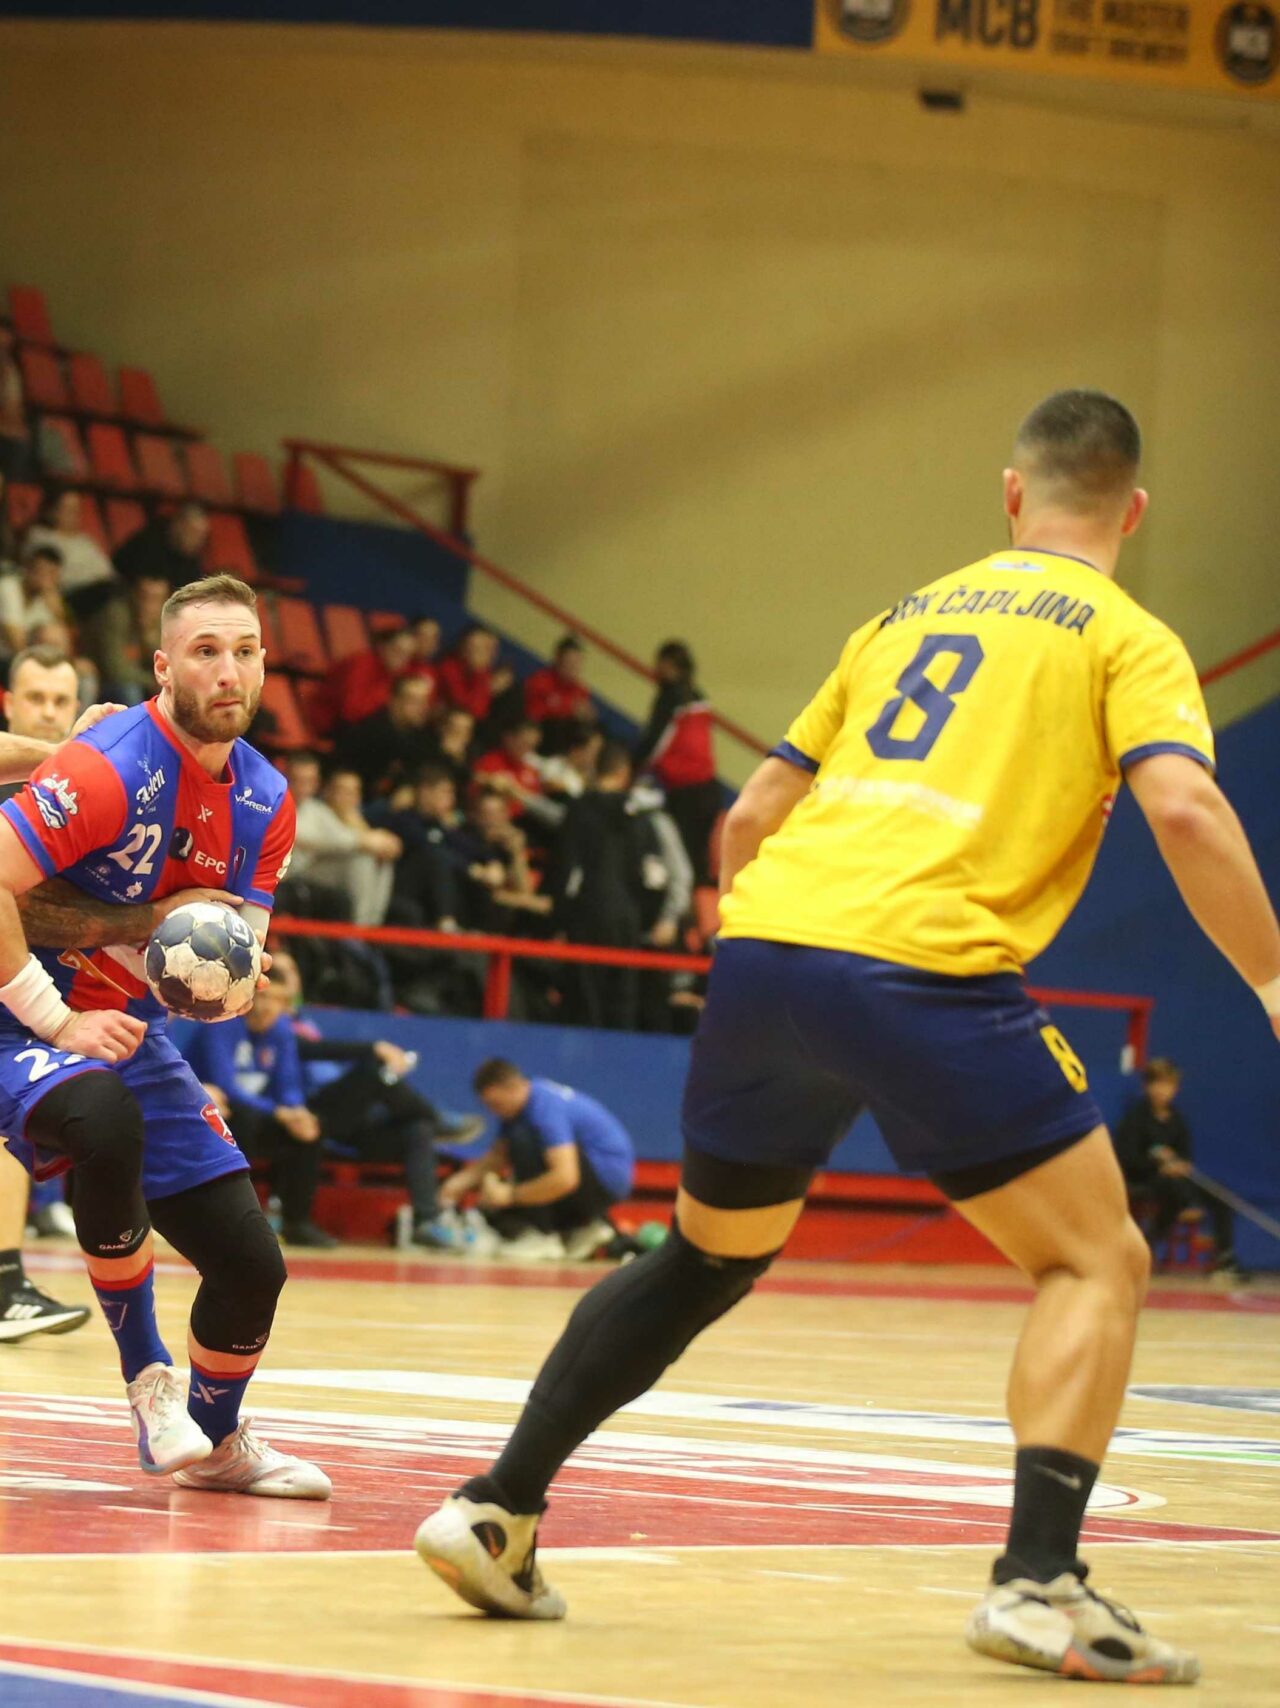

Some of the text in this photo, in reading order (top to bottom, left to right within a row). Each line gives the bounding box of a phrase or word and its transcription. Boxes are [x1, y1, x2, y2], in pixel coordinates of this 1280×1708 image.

[865, 633, 985, 762] 8
[106, 822, 163, 875] 22
[194, 850, 228, 875] EPC
